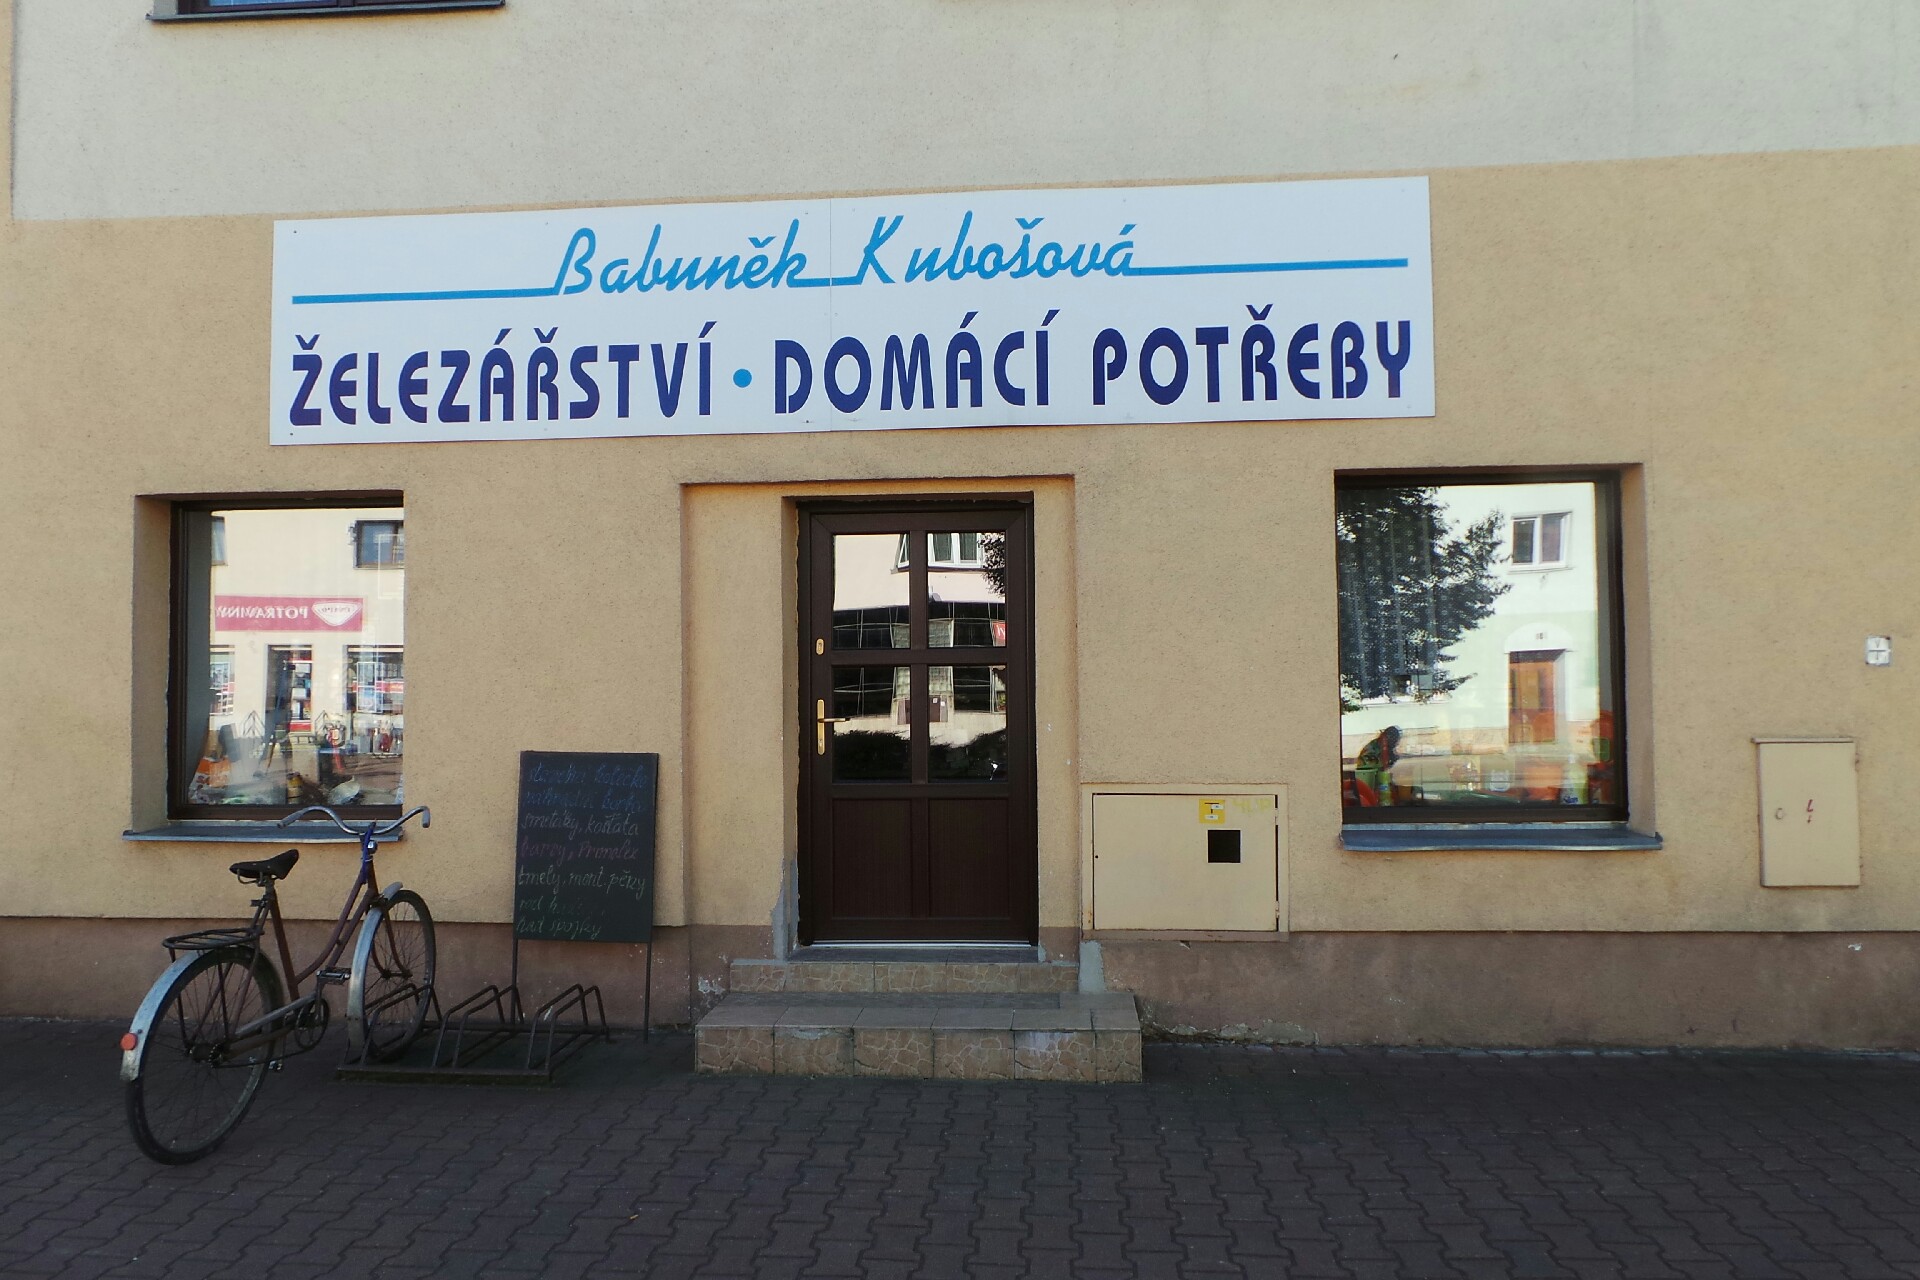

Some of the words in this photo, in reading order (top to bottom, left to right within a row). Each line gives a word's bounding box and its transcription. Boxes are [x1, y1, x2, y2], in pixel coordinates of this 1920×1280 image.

[553, 218, 808, 296] Babuněk
[857, 210, 1137, 286] Kubošová
[289, 321, 718, 427] ŽELEZÁŘSTVÍ
[774, 309, 1061, 414] DOMÁCÍ
[1092, 304, 1411, 406] POTŘEBY
